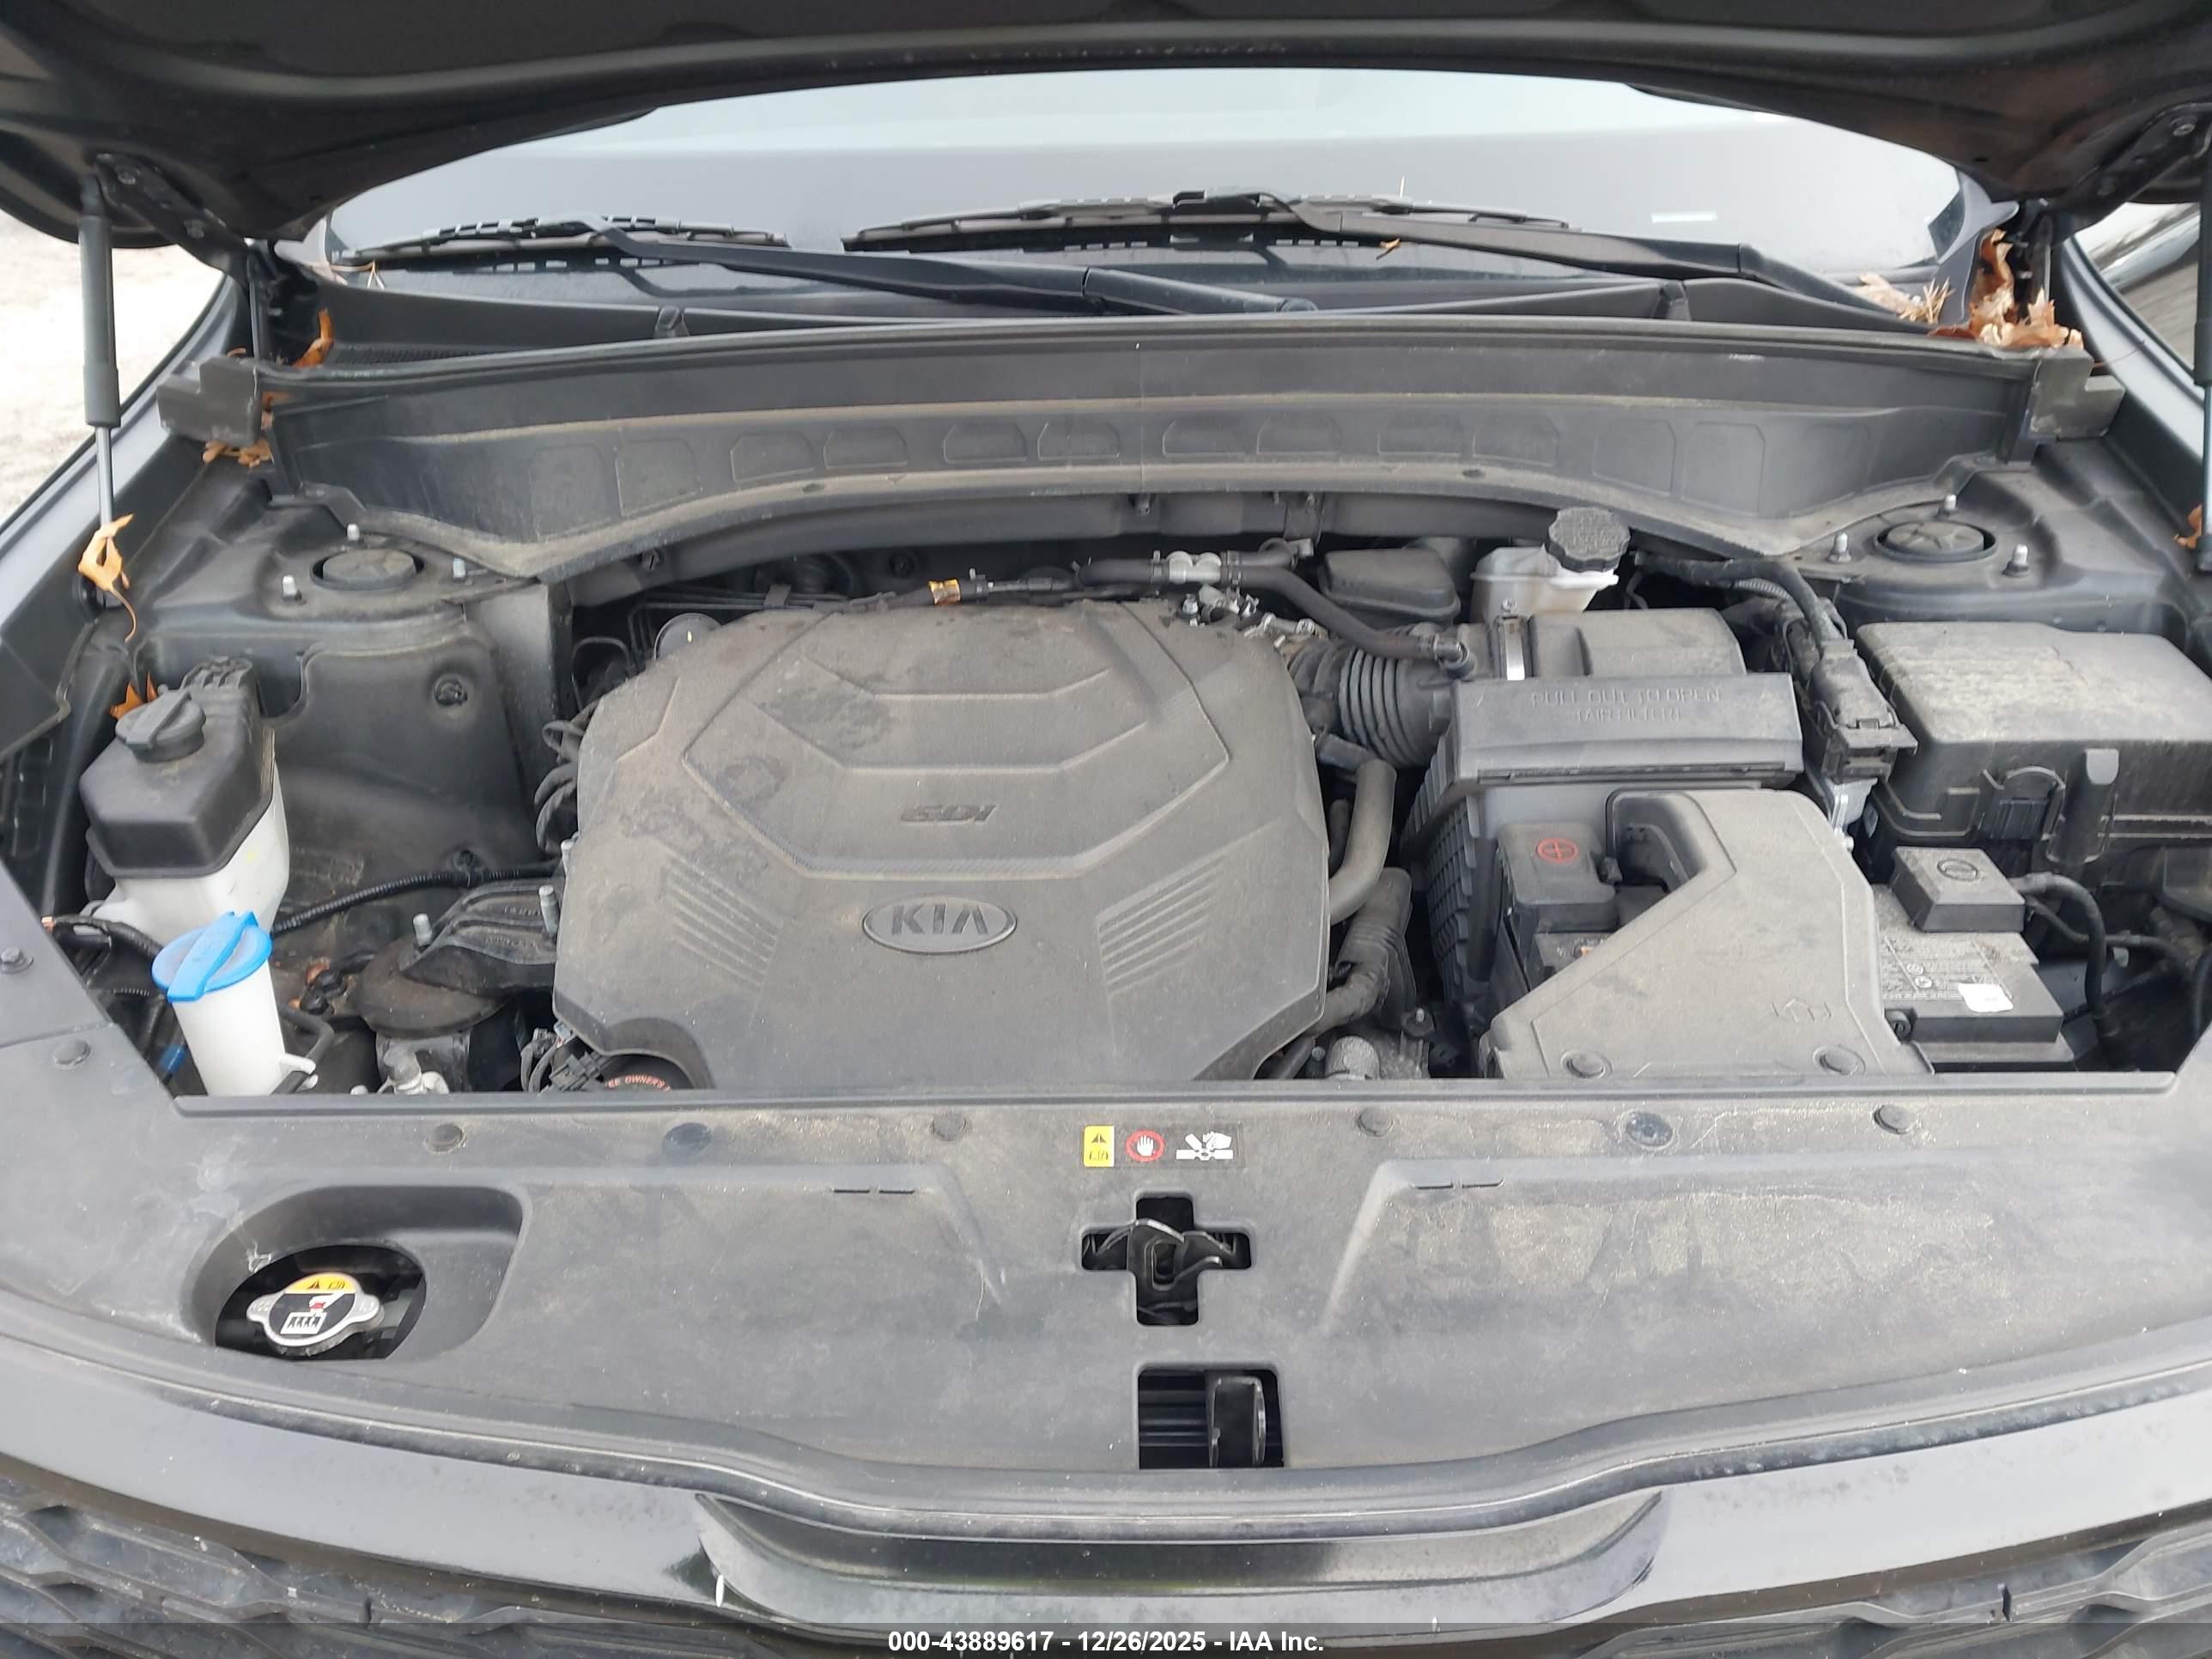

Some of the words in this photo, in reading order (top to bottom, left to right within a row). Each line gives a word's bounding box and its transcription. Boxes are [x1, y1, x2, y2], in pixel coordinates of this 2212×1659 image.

[1532, 690, 1578, 708] PULL
[1589, 688, 1629, 706] OUT
[1666, 686, 1722, 702] OPEN
[891, 902, 989, 935] KIA
